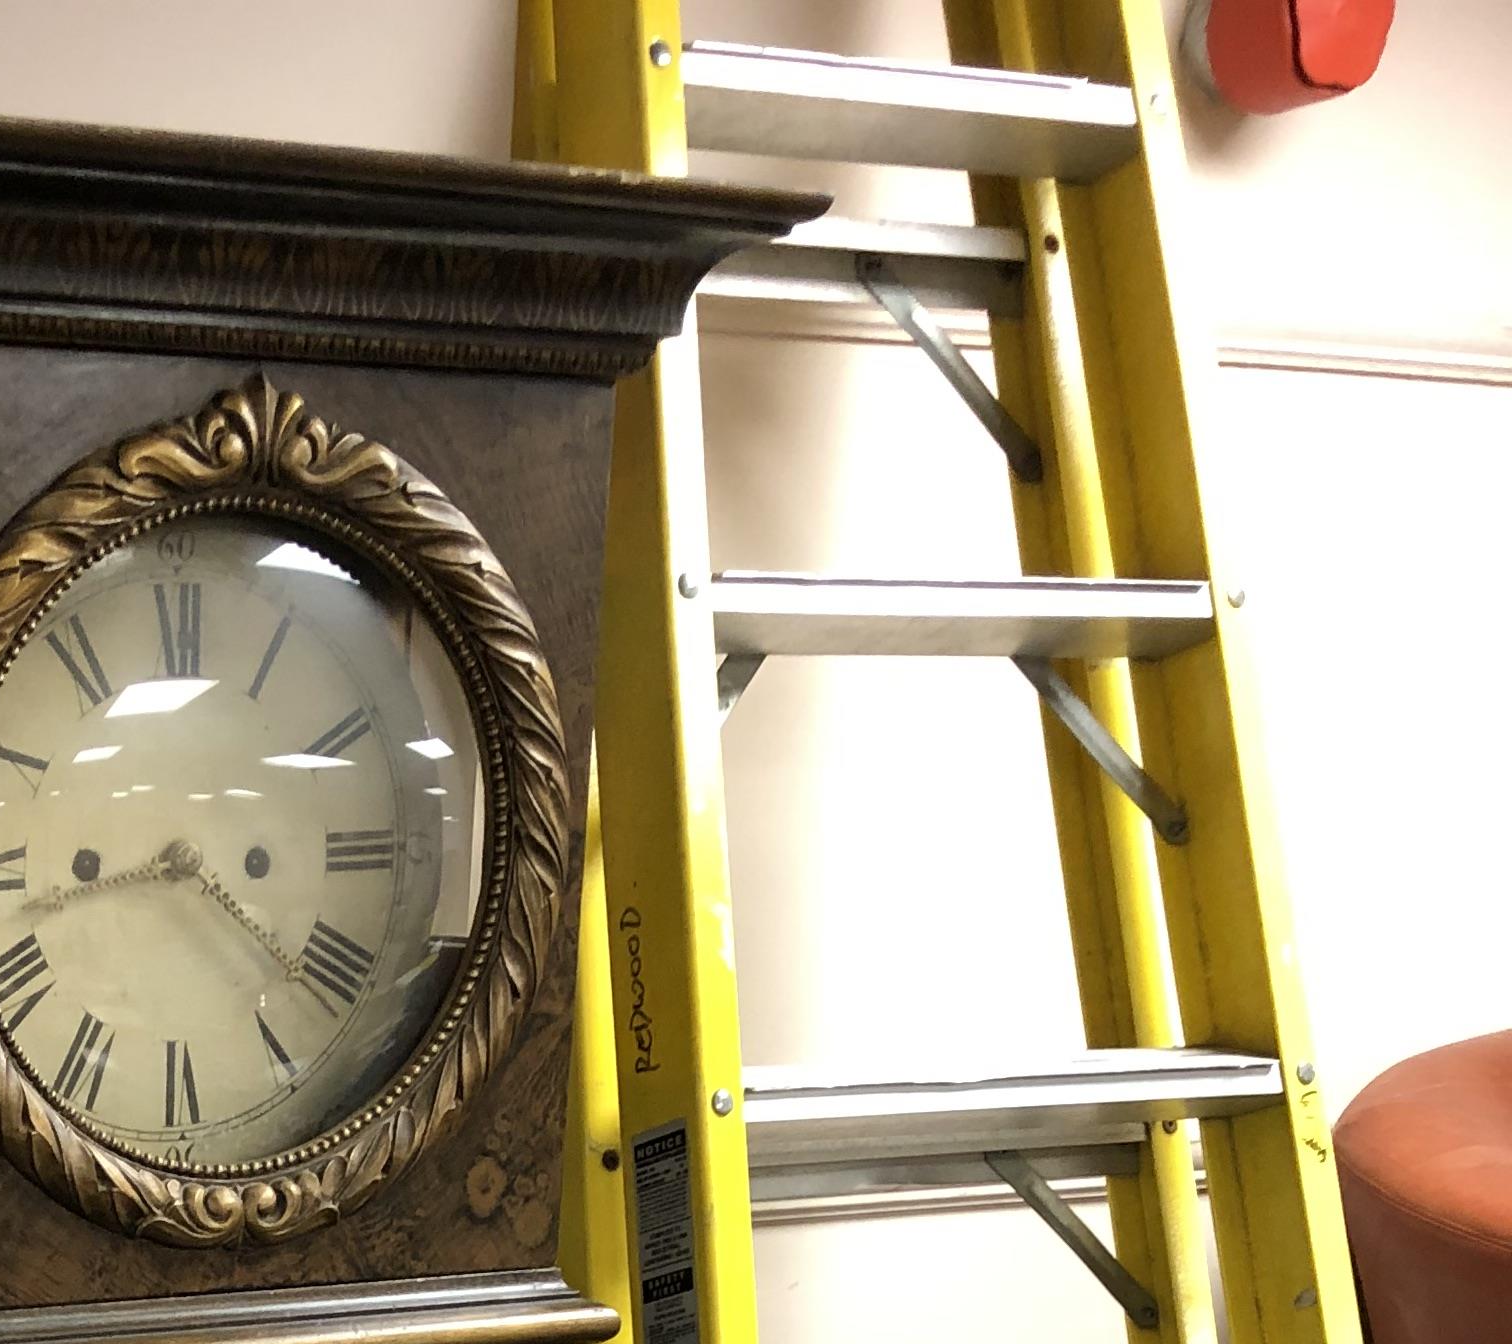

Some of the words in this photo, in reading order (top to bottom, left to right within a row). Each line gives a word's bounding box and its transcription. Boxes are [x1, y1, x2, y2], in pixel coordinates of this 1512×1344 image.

[157, 532, 196, 562] 60
[44, 613, 122, 717] XI
[152, 581, 202, 679] XII
[325, 827, 395, 878] III
[289, 914, 377, 1007] IIII
[53, 1003, 117, 1114] VII
[163, 1038, 206, 1129] VI
[253, 1009, 300, 1090] V
[637, 1133, 684, 1161] NOTICE
